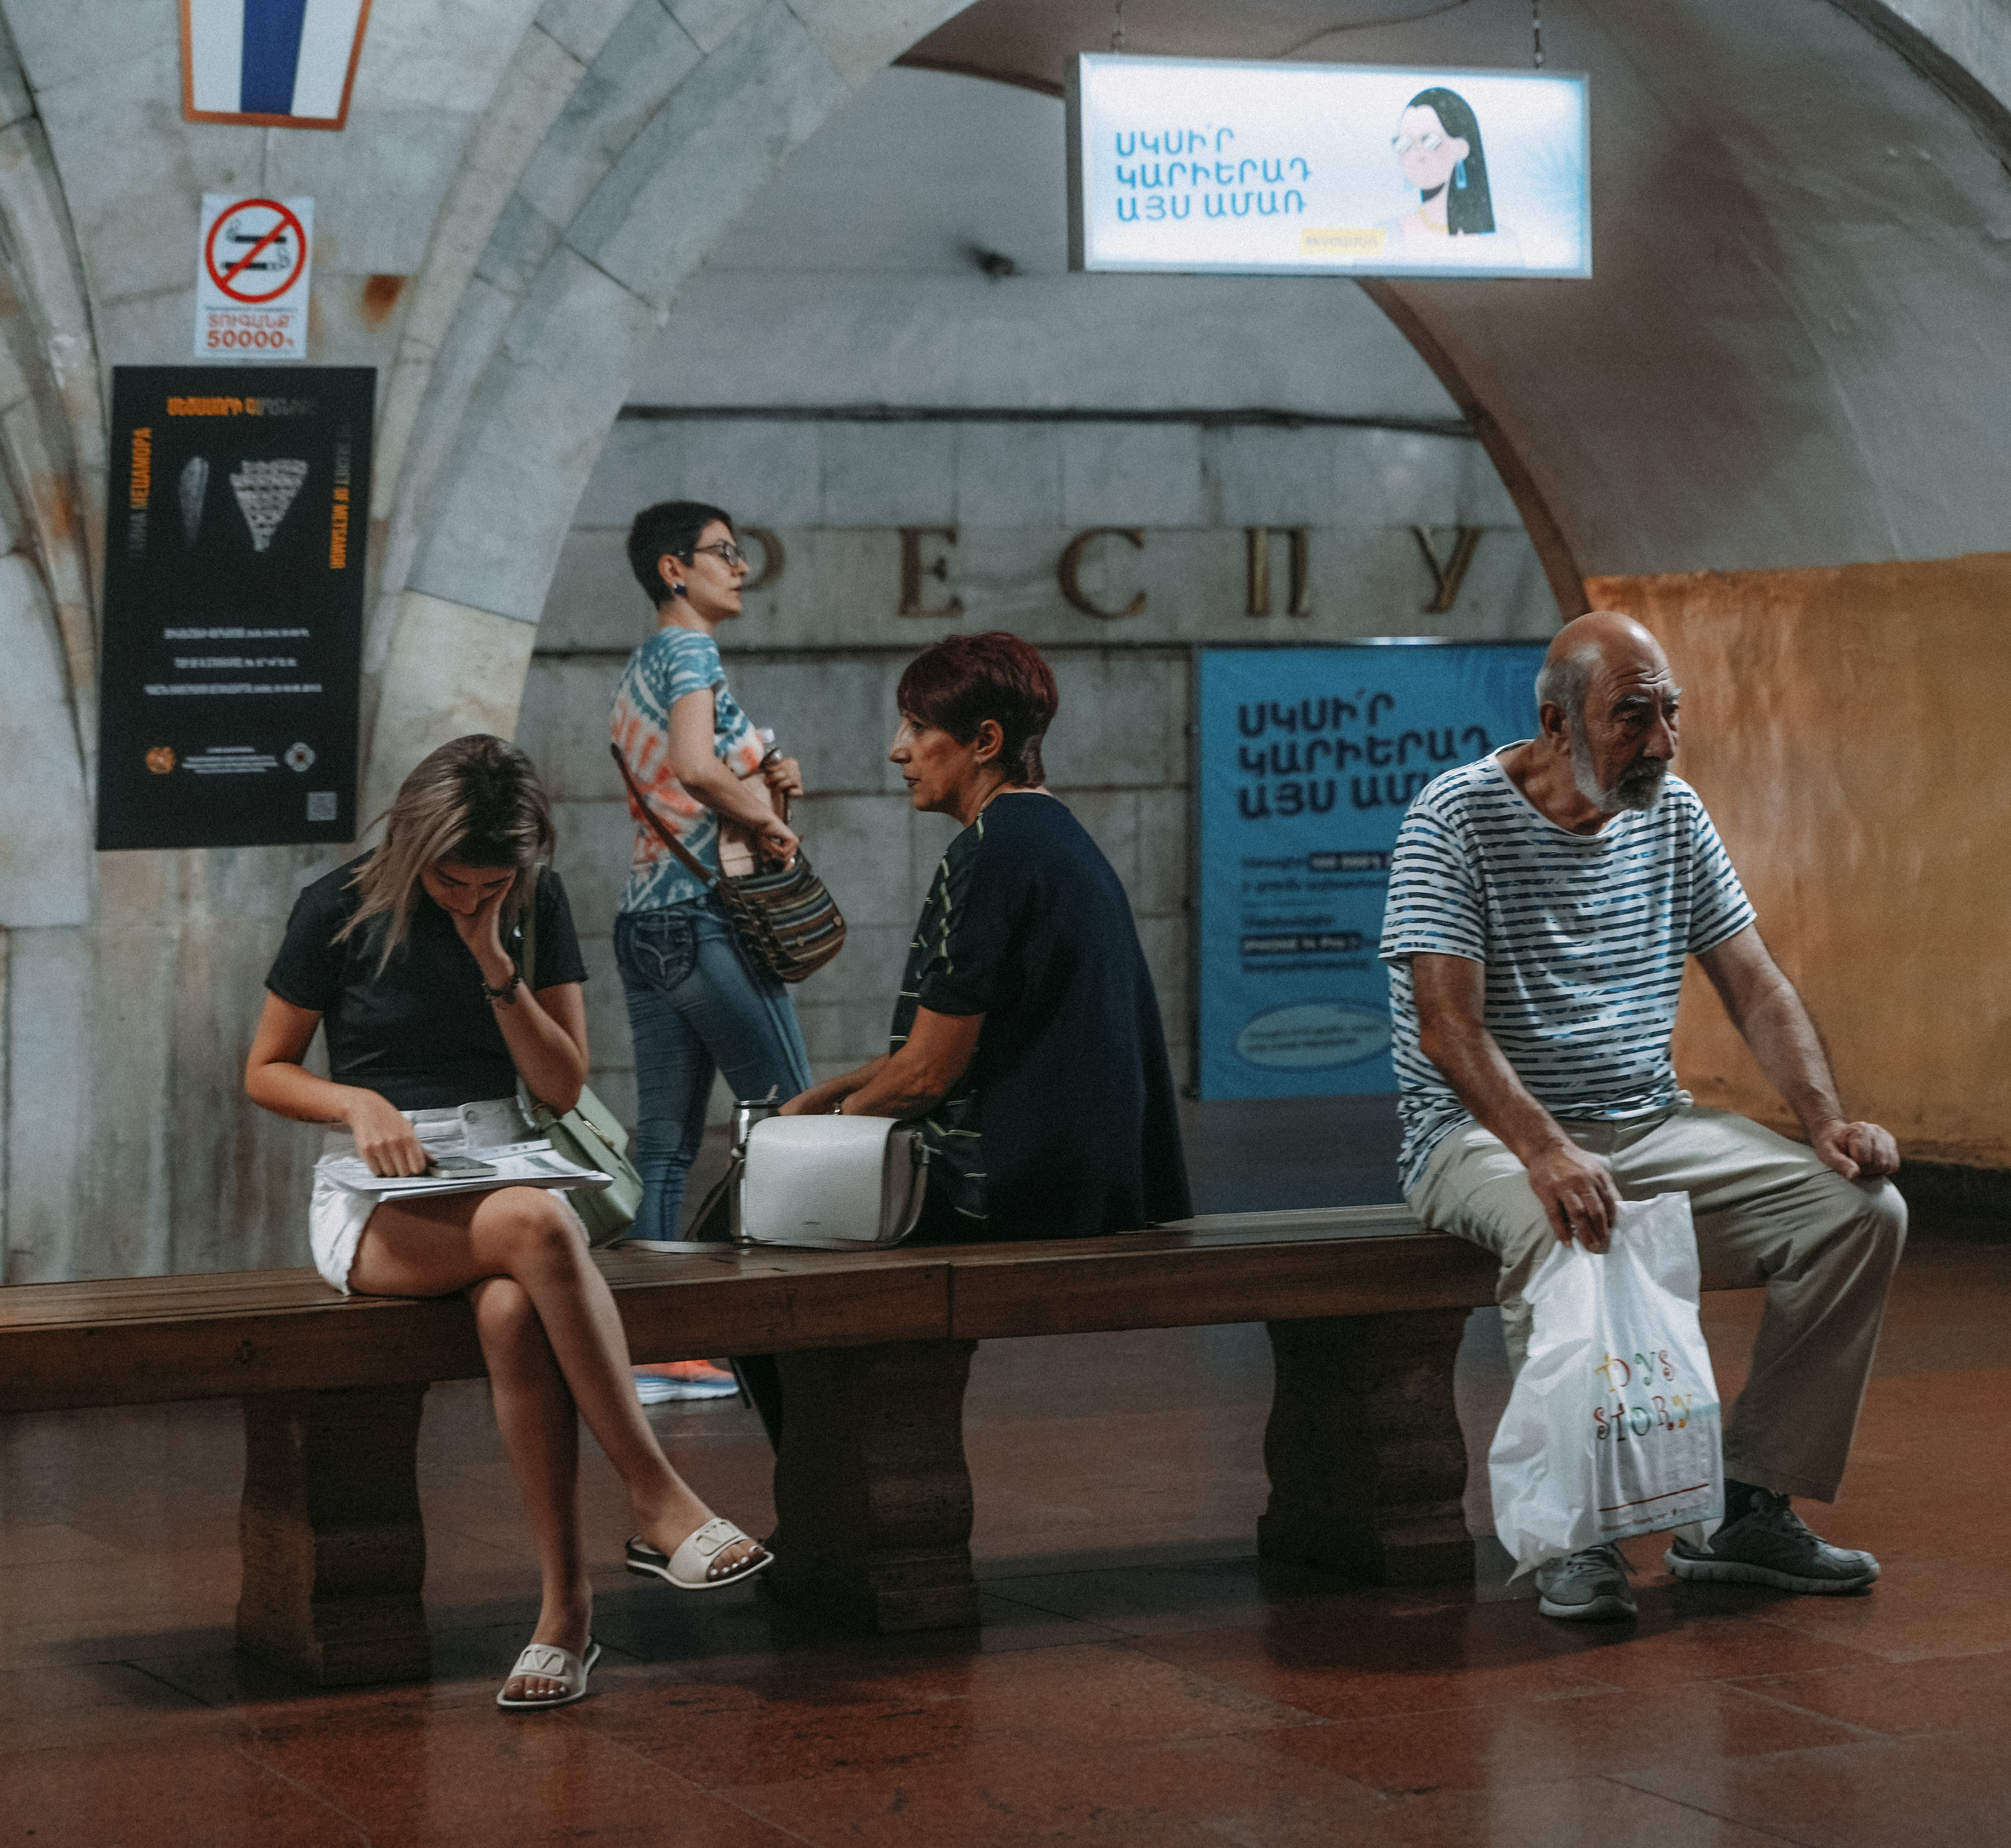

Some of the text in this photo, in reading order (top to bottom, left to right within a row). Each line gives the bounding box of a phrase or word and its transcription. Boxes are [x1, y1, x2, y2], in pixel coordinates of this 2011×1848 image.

[1116, 157, 1312, 190] ԿԱՐԻԵՐԱԴ
[1117, 189, 1306, 222] ԱՅՍ ԱՄԱՌ
[1239, 779, 1335, 820] ԱՅՍ
[1592, 1393, 1693, 1443] STORY
